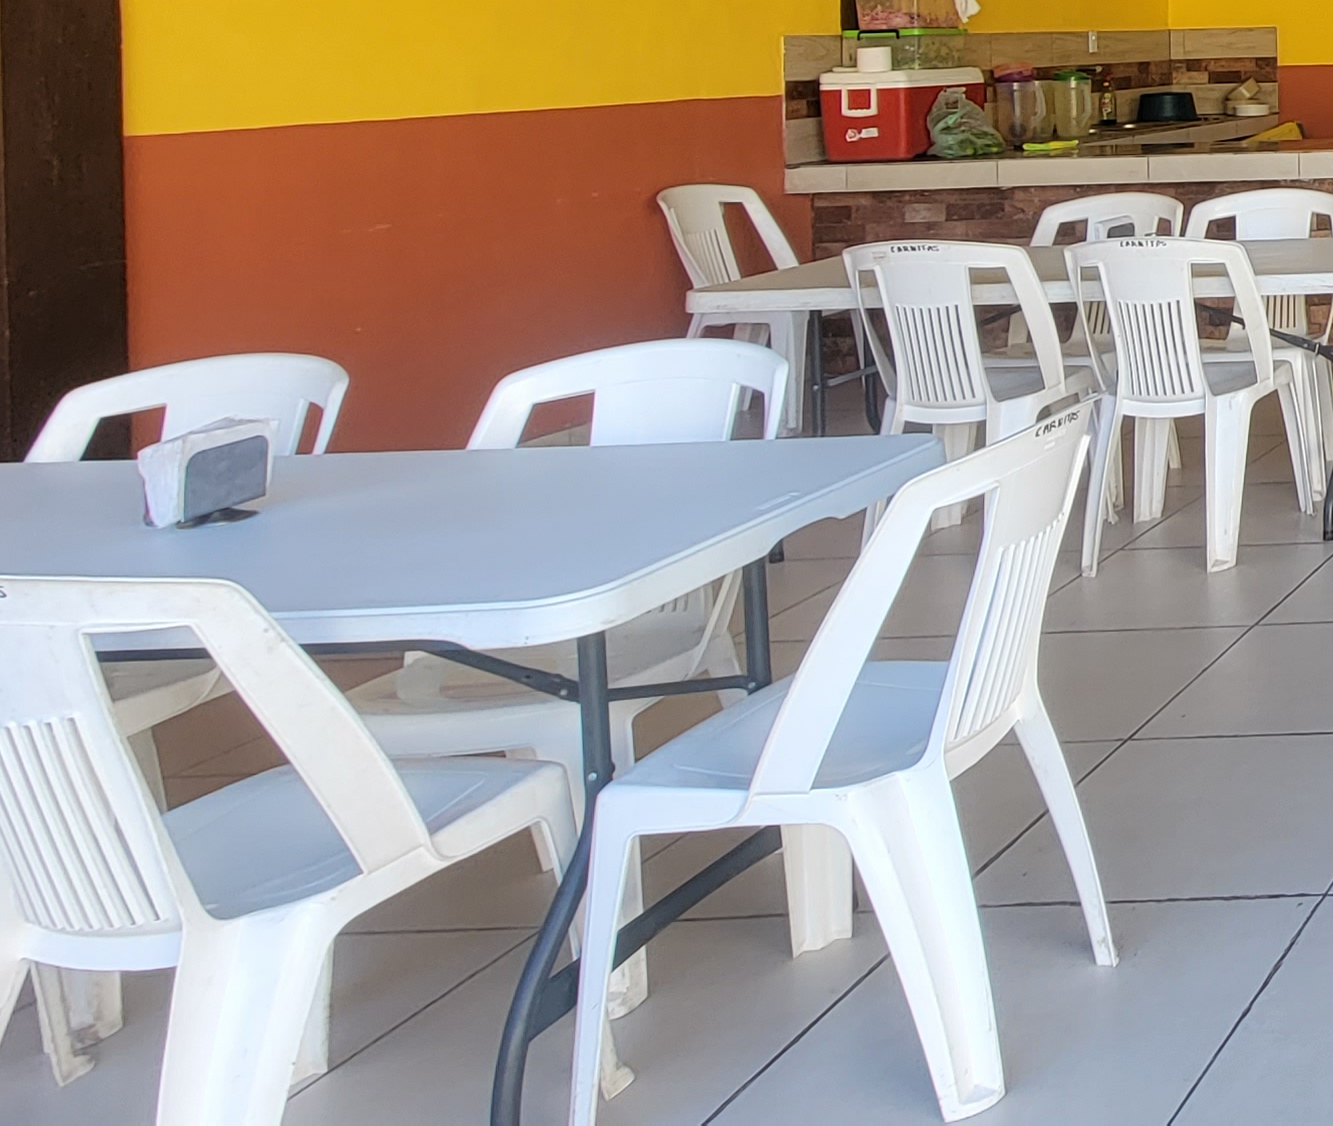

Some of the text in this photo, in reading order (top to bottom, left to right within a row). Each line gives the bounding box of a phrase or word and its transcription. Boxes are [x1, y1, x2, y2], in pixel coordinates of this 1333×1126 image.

[1119, 239, 1167, 248] CARNITAS
[890, 244, 940, 253] CARNITAS
[1034, 409, 1081, 438] CARNITAS
